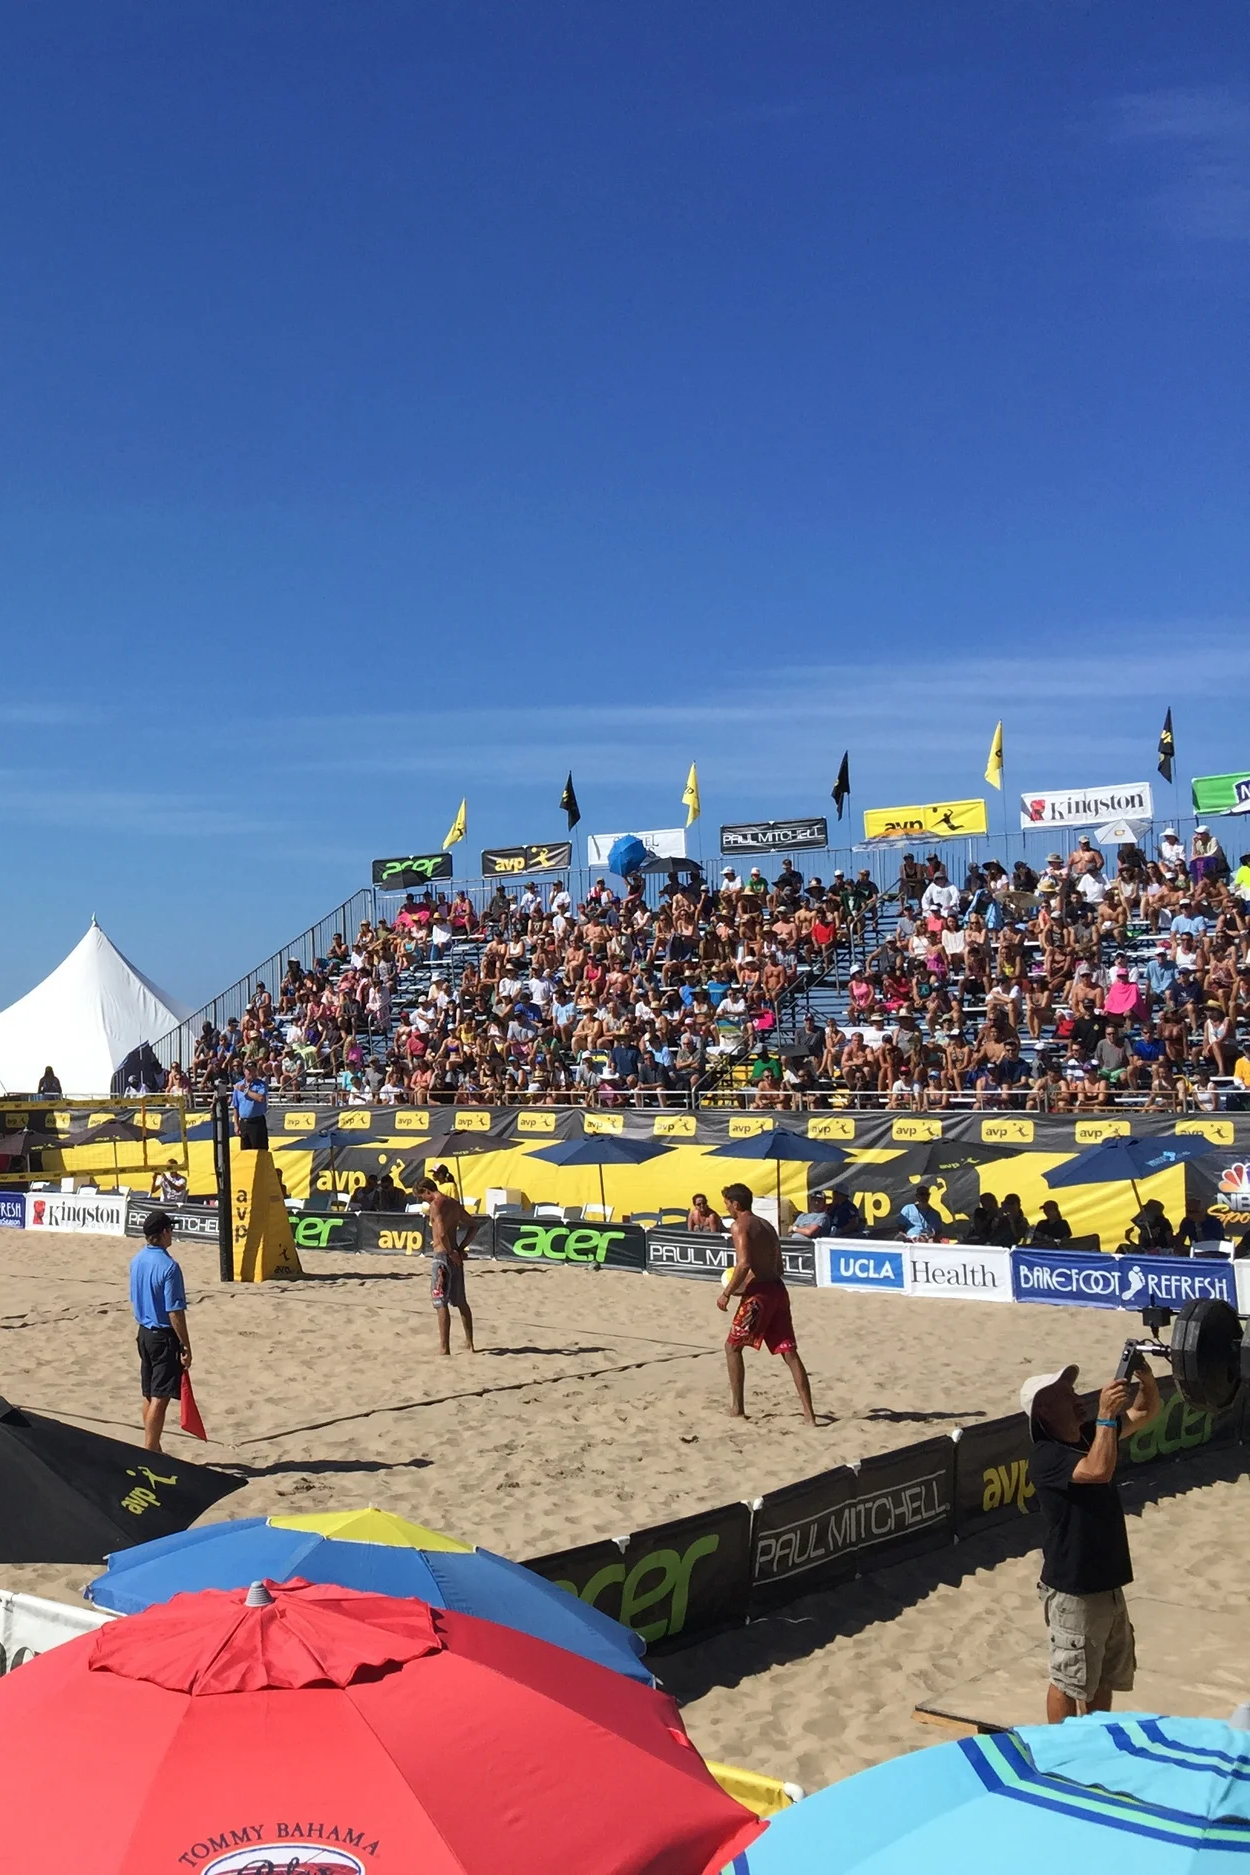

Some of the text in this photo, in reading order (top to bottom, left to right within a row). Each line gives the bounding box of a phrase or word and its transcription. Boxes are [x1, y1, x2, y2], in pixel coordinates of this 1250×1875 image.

[1050, 791, 1144, 821] Kingston
[722, 825, 826, 846] PAUL MITCHELL
[494, 856, 526, 874] avp
[286, 1119, 300, 1127] avp
[398, 1116, 413, 1126] avp
[457, 1117, 473, 1127] avp
[520, 1118, 537, 1128] avp
[587, 1119, 604, 1130] avp
[657, 1122, 675, 1133] avp
[732, 1123, 751, 1134] avp
[811, 1125, 831, 1134] avp
[896, 1126, 917, 1137] avp
[985, 1127, 1008, 1139] avp
[1079, 1128, 1103, 1139] avp
[316, 1169, 367, 1196] avp
[1217, 1192, 1250, 1211] NB
[49, 1200, 120, 1227] Kingston
[378, 1229, 423, 1256] avp
[512, 1225, 626, 1263] acer
[649, 1245, 704, 1265] PAUL
[839, 1257, 998, 1288] UCLA Health
[1019, 1265, 1228, 1301] BAREFOOT REFRESH
[120, 1486, 162, 1516] avp
[755, 1480, 950, 1577] PAUL MITCHELL
[177, 1824, 265, 1868] TOMMY
[276, 1821, 380, 1857] BAHAMA
